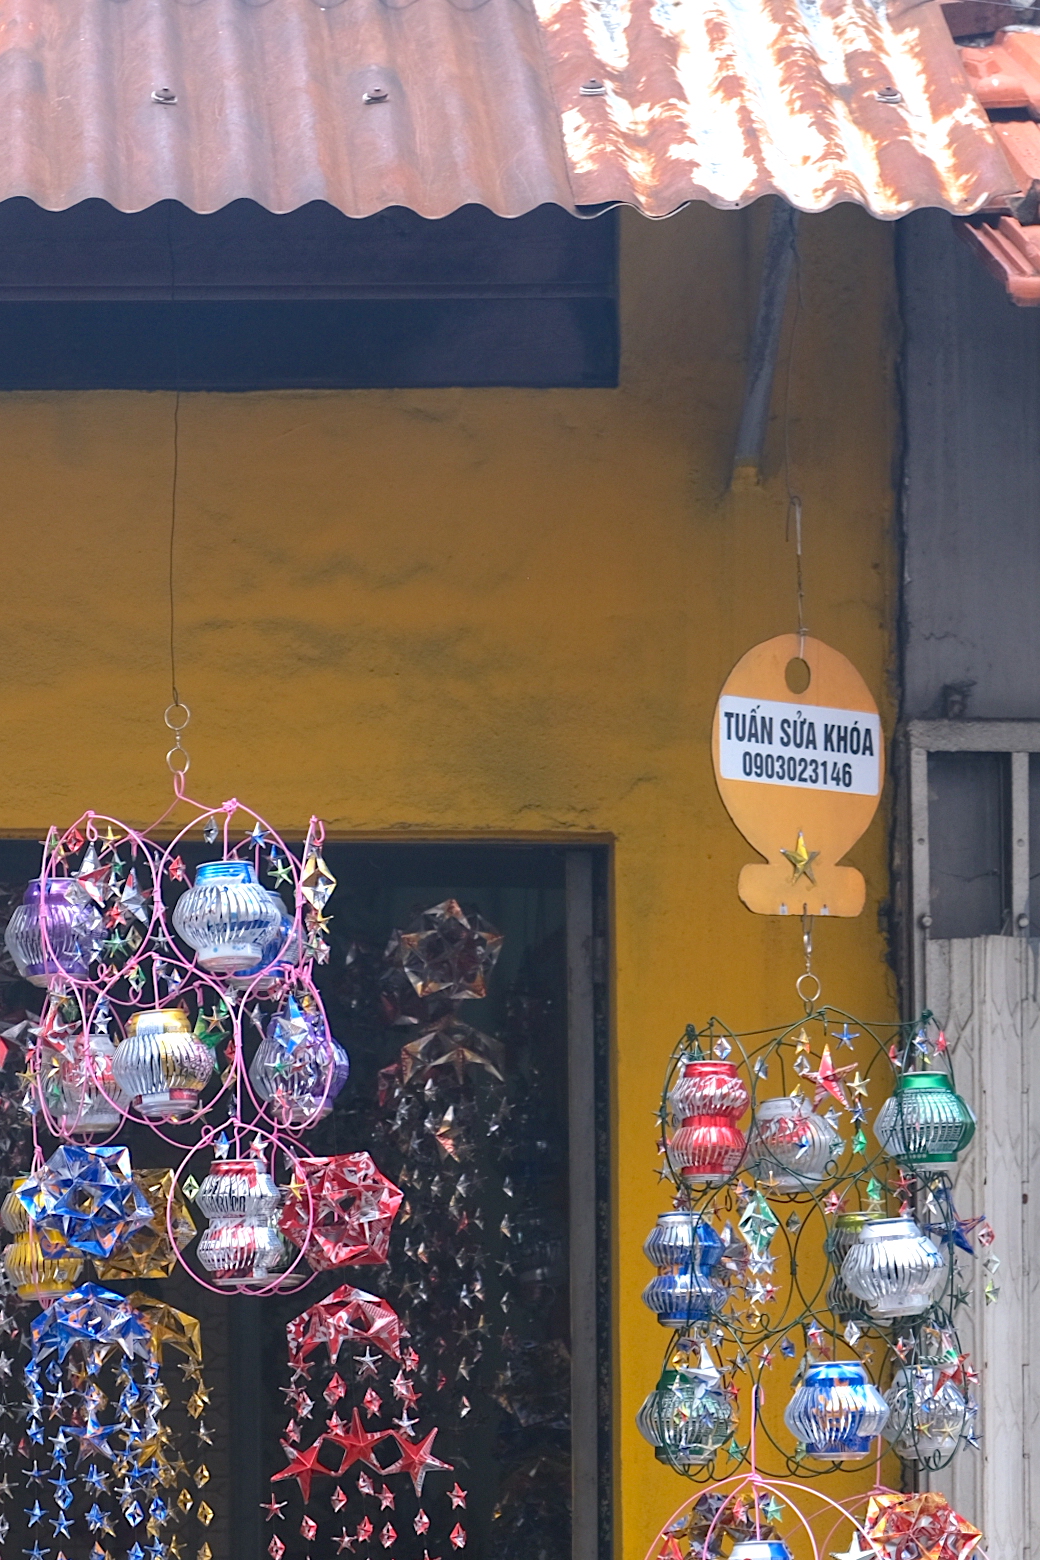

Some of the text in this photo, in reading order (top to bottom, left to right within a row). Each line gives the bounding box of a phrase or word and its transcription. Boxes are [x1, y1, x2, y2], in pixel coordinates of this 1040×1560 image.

[724, 704, 874, 756] TUẤN SỬA KHÓA
[742, 751, 852, 788] 0903023146
